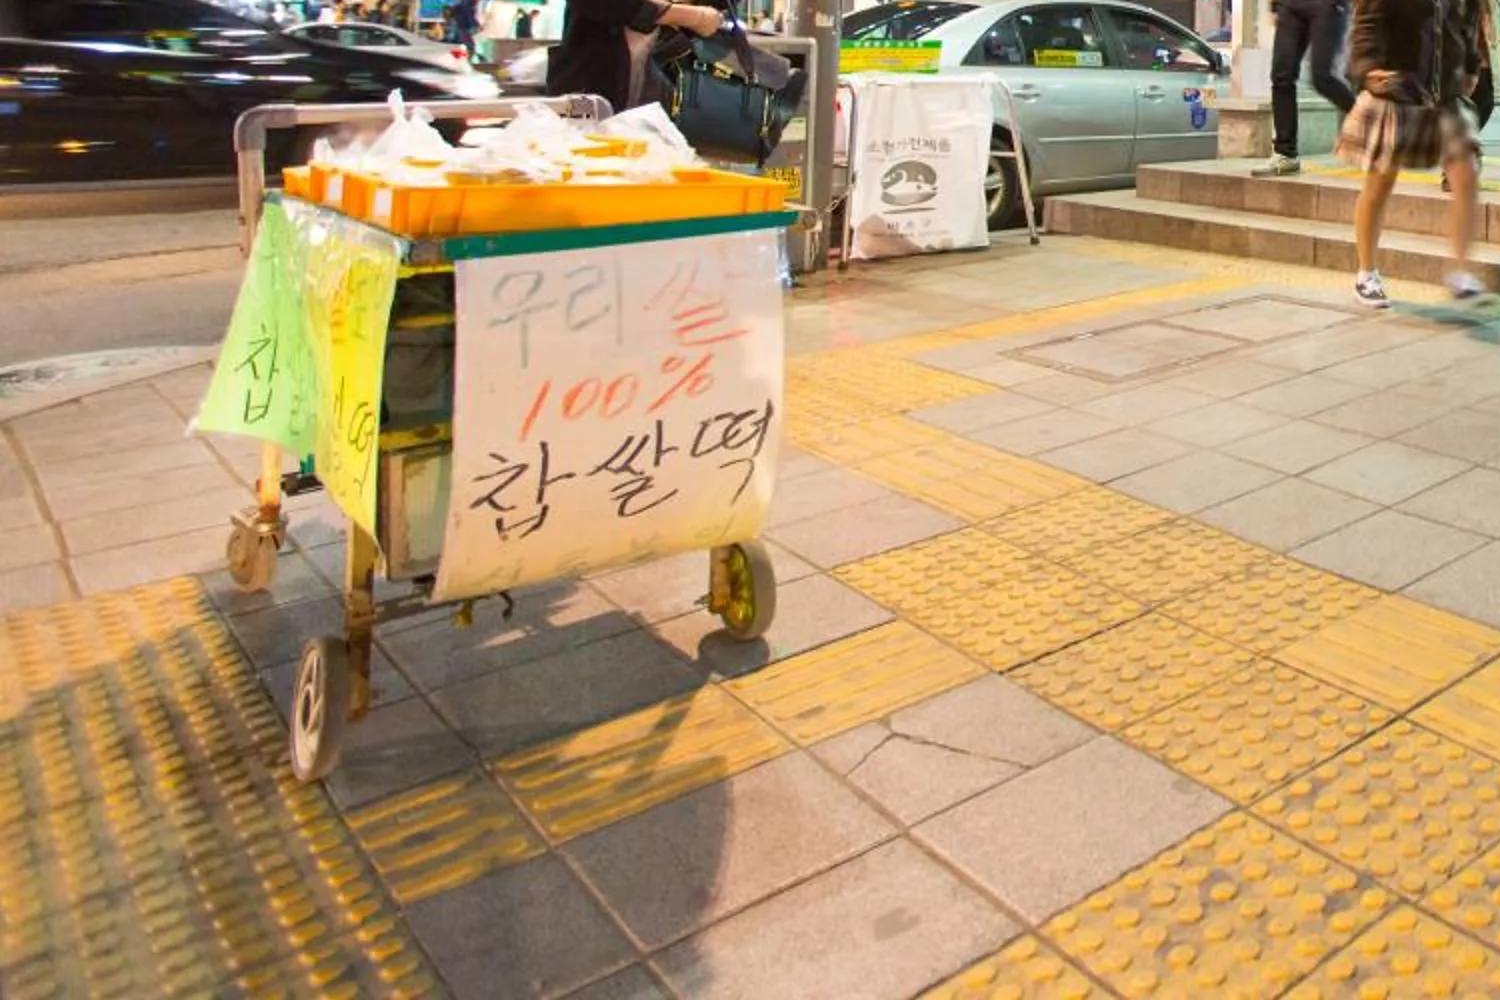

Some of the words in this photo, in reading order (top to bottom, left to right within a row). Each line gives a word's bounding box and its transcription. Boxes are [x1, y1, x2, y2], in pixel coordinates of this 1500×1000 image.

[488, 255, 624, 369] 우리
[516, 352, 715, 443] 100%
[469, 399, 774, 542] 찹쌀떡
